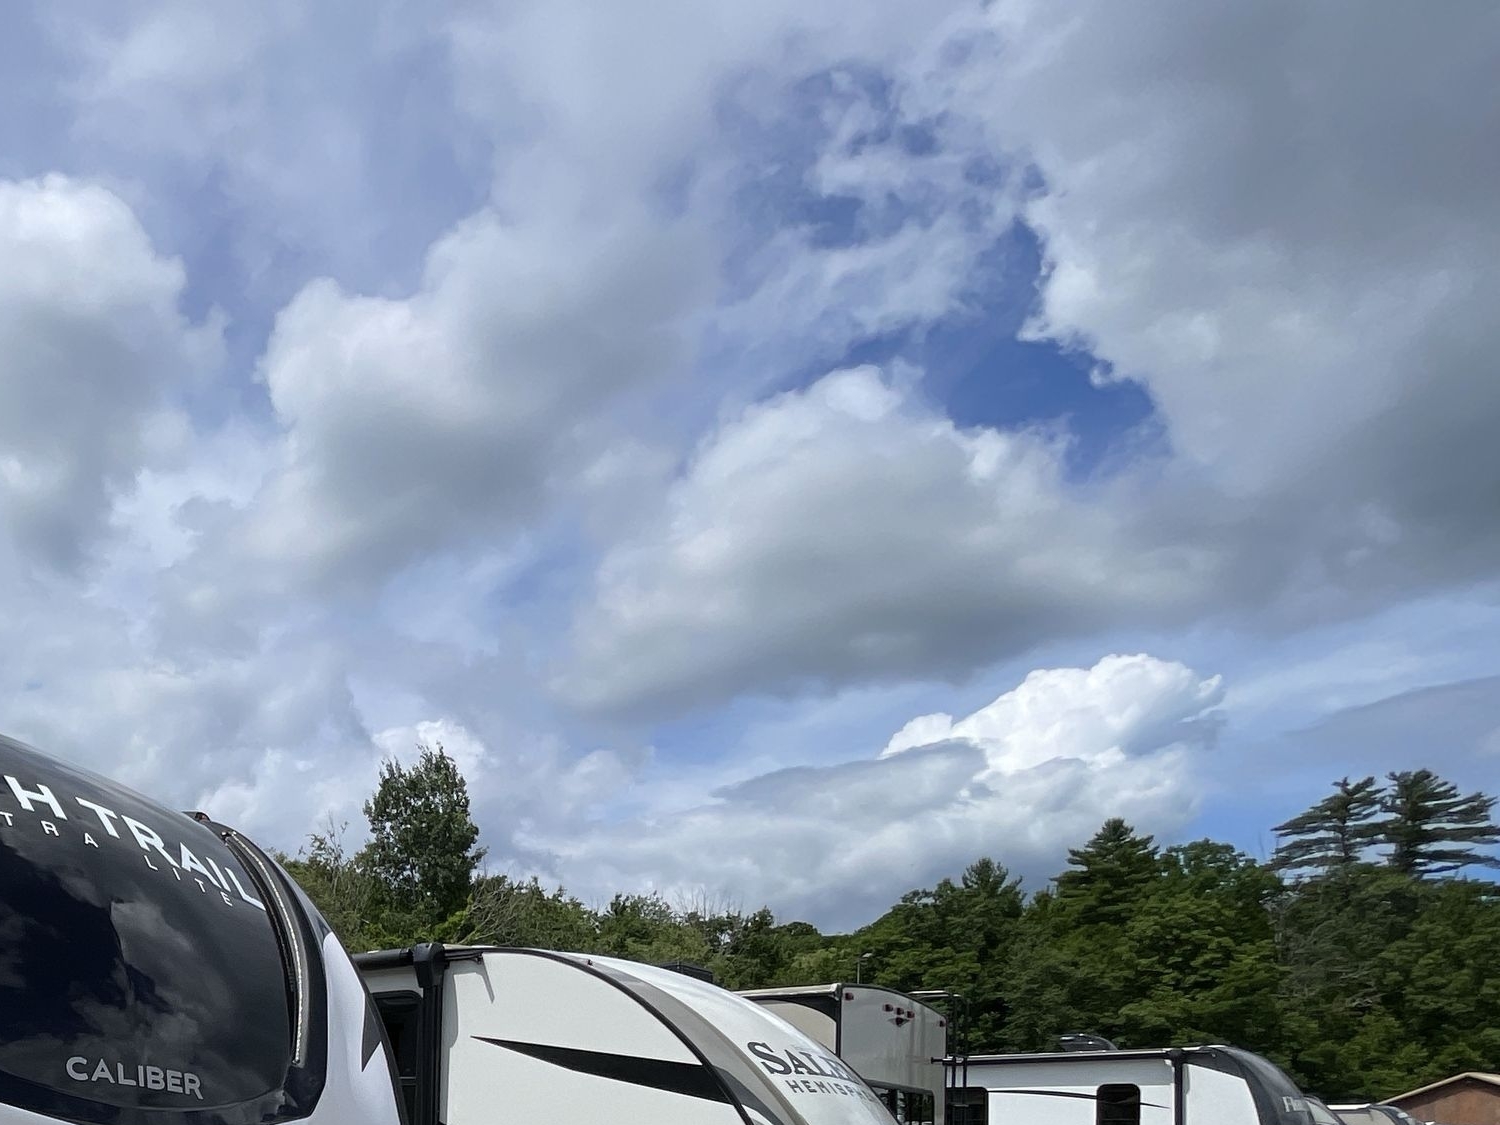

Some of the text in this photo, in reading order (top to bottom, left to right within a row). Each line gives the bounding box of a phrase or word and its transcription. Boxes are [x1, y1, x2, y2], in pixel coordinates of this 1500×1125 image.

[75, 796, 267, 911] TRAIL
[144, 854, 233, 907] LITE
[65, 1056, 204, 1100] CALIBER
[747, 1041, 861, 1086] SALE
